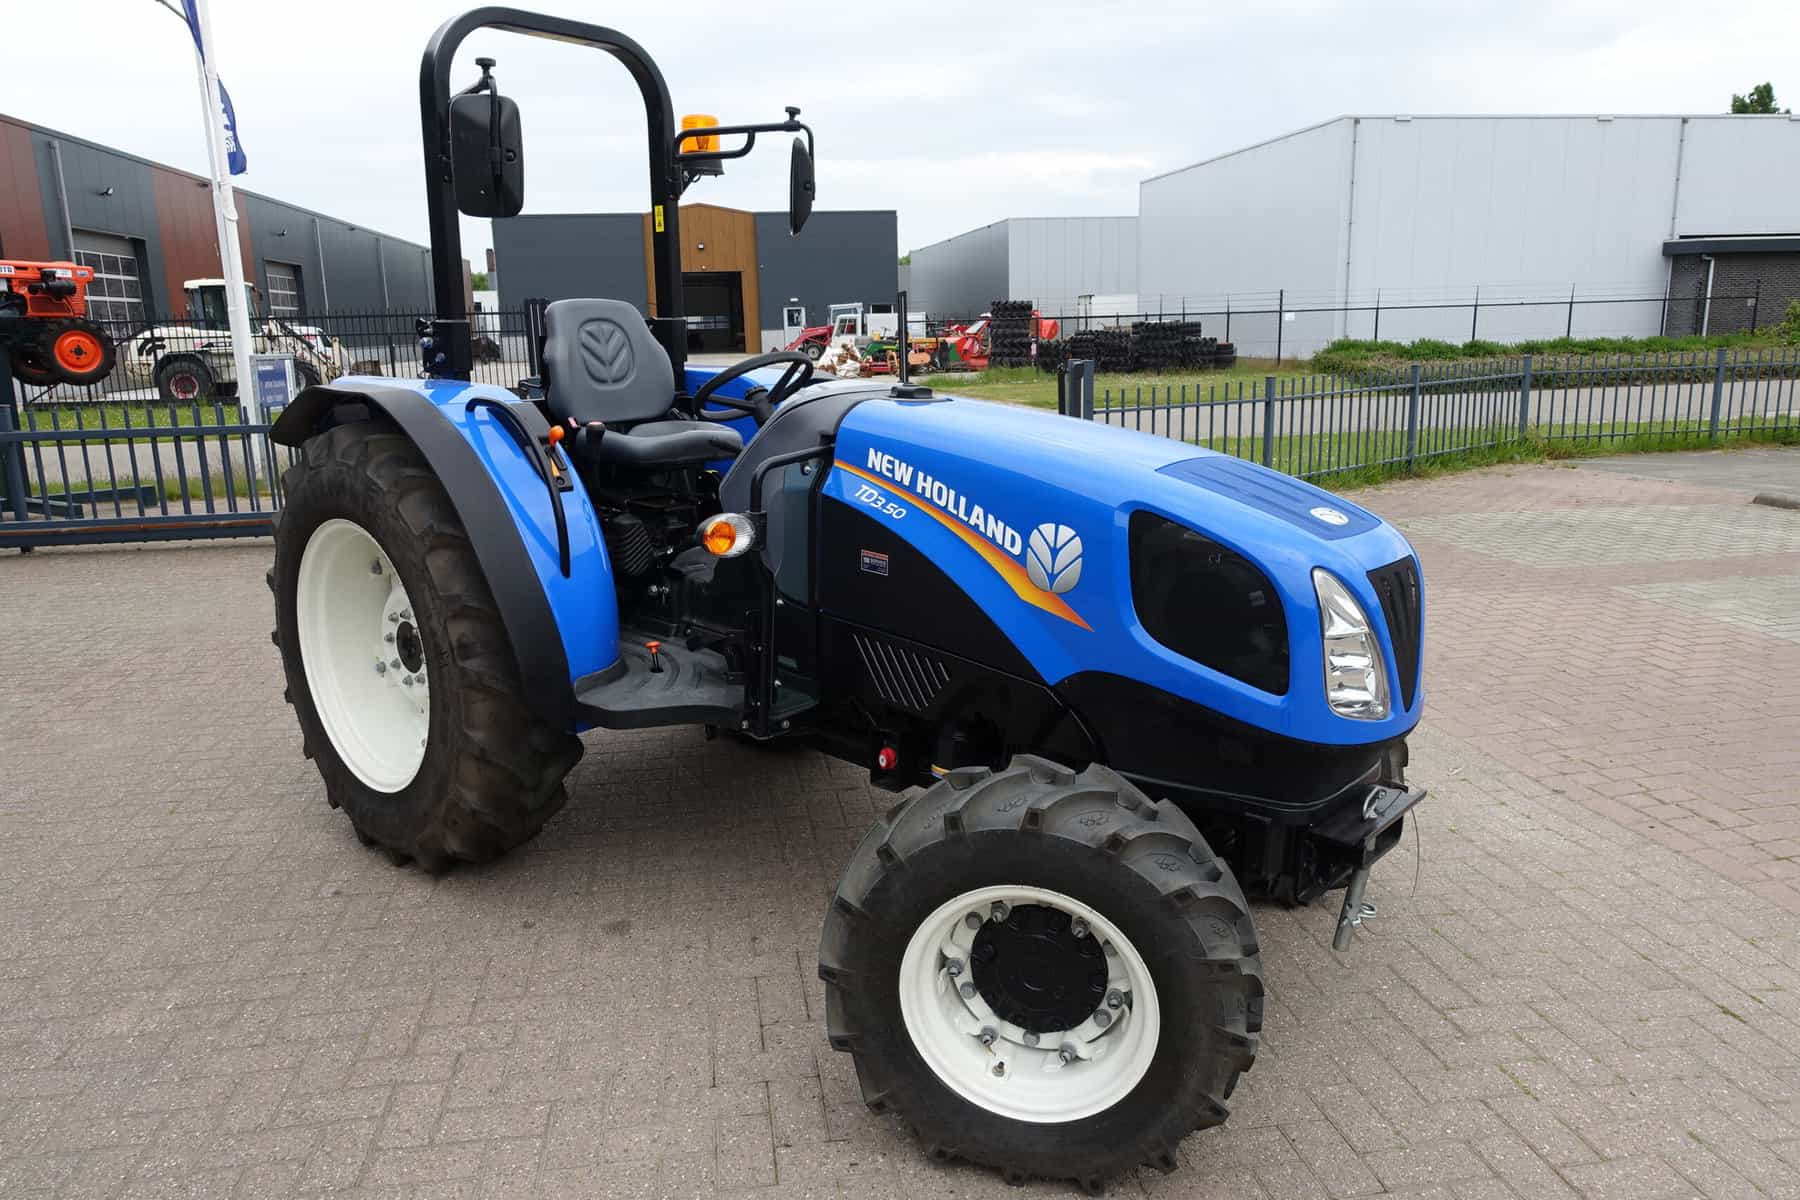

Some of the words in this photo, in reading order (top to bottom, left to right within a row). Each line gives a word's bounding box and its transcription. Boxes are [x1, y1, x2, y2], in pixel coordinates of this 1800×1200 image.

[854, 484, 907, 520] TD3.50
[867, 447, 914, 486] NEW
[916, 470, 1022, 556] HOLLAND
